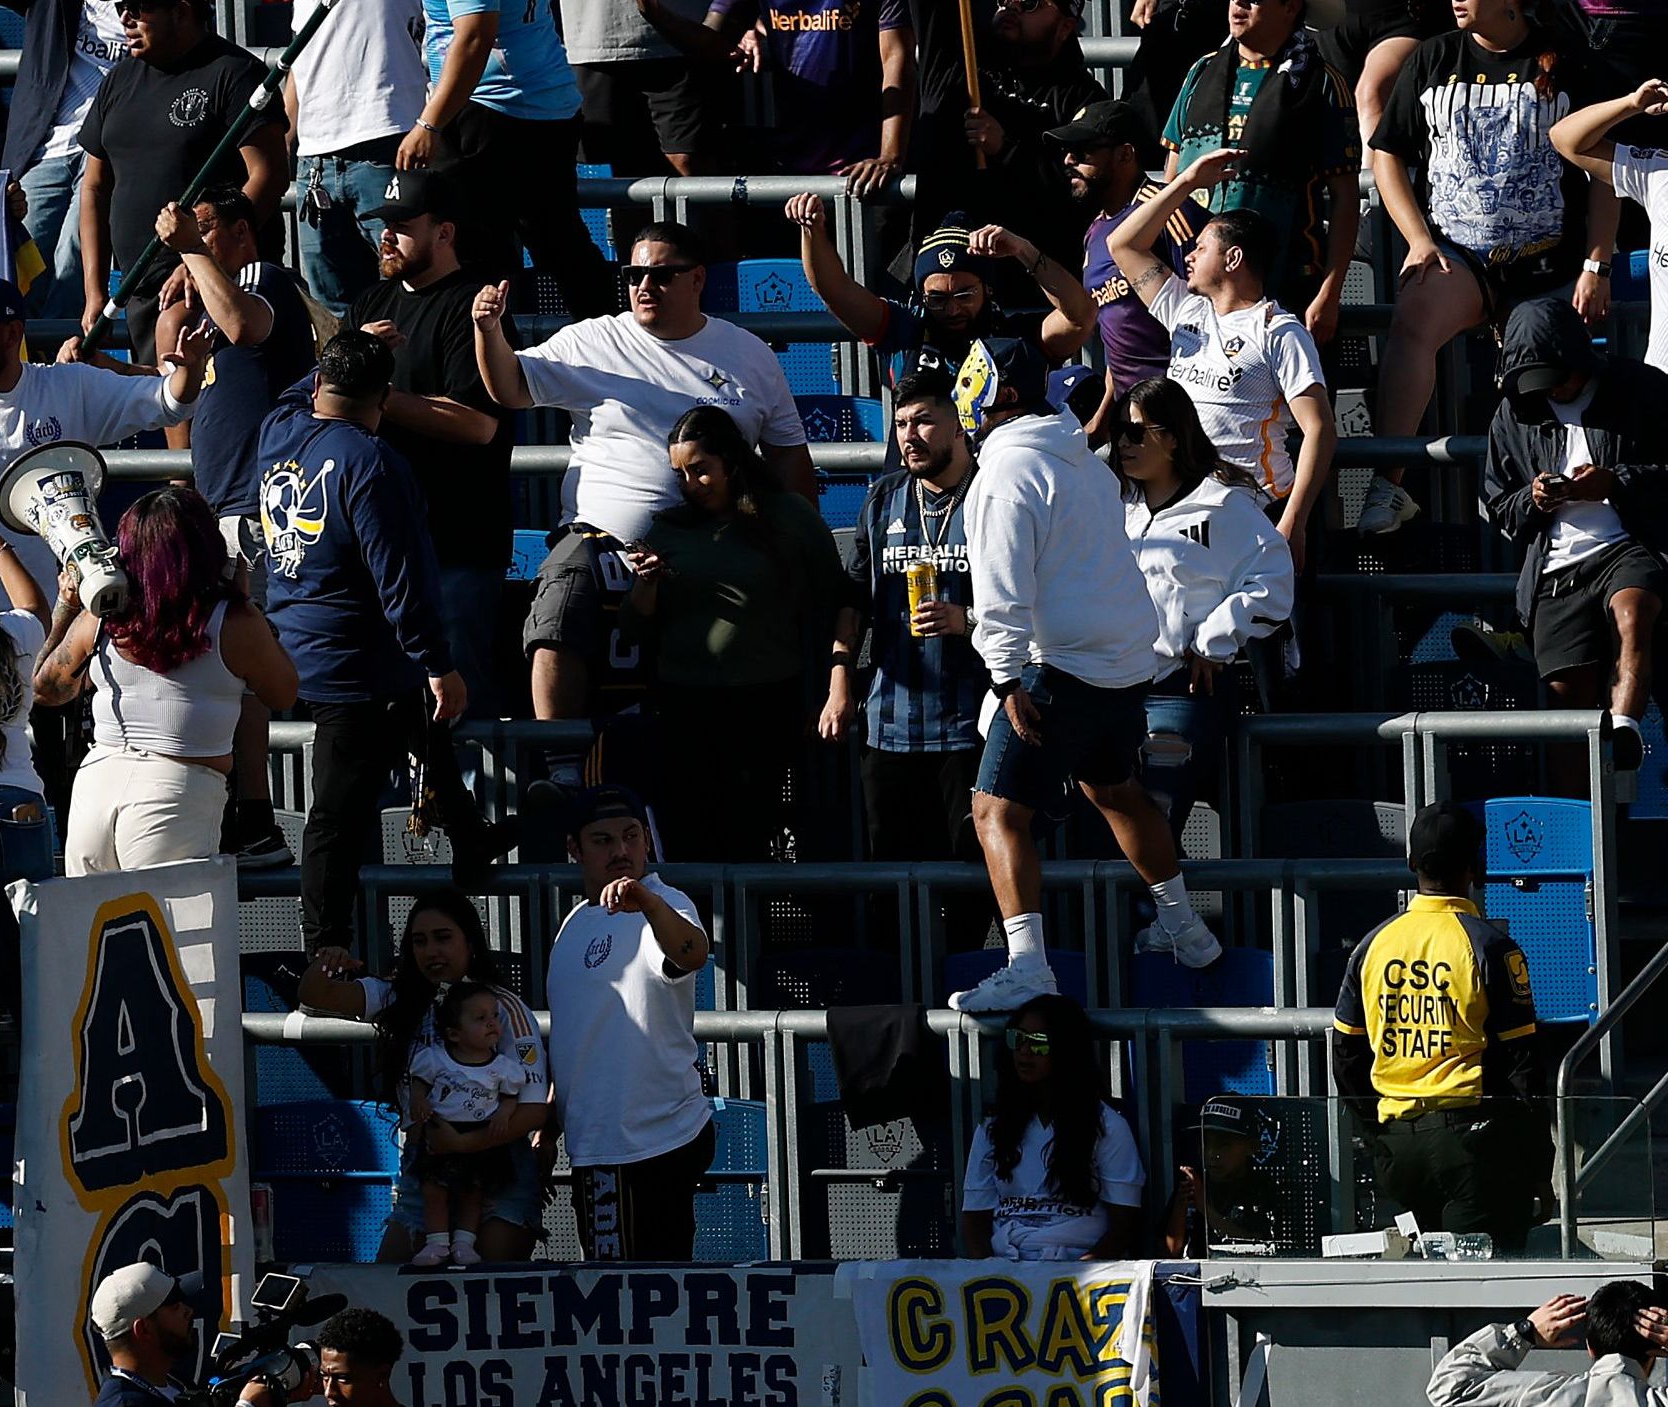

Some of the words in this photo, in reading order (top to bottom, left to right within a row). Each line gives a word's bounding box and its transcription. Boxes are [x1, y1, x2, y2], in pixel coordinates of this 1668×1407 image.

[769, 8, 851, 33] Herbalife
[1383, 958, 1452, 991] CSC
[1378, 995, 1459, 1024] SECURITY
[1381, 1028, 1454, 1060] STAFF
[407, 1275, 796, 1353] SIEMPRE
[541, 1355, 797, 1407] ANGELES
